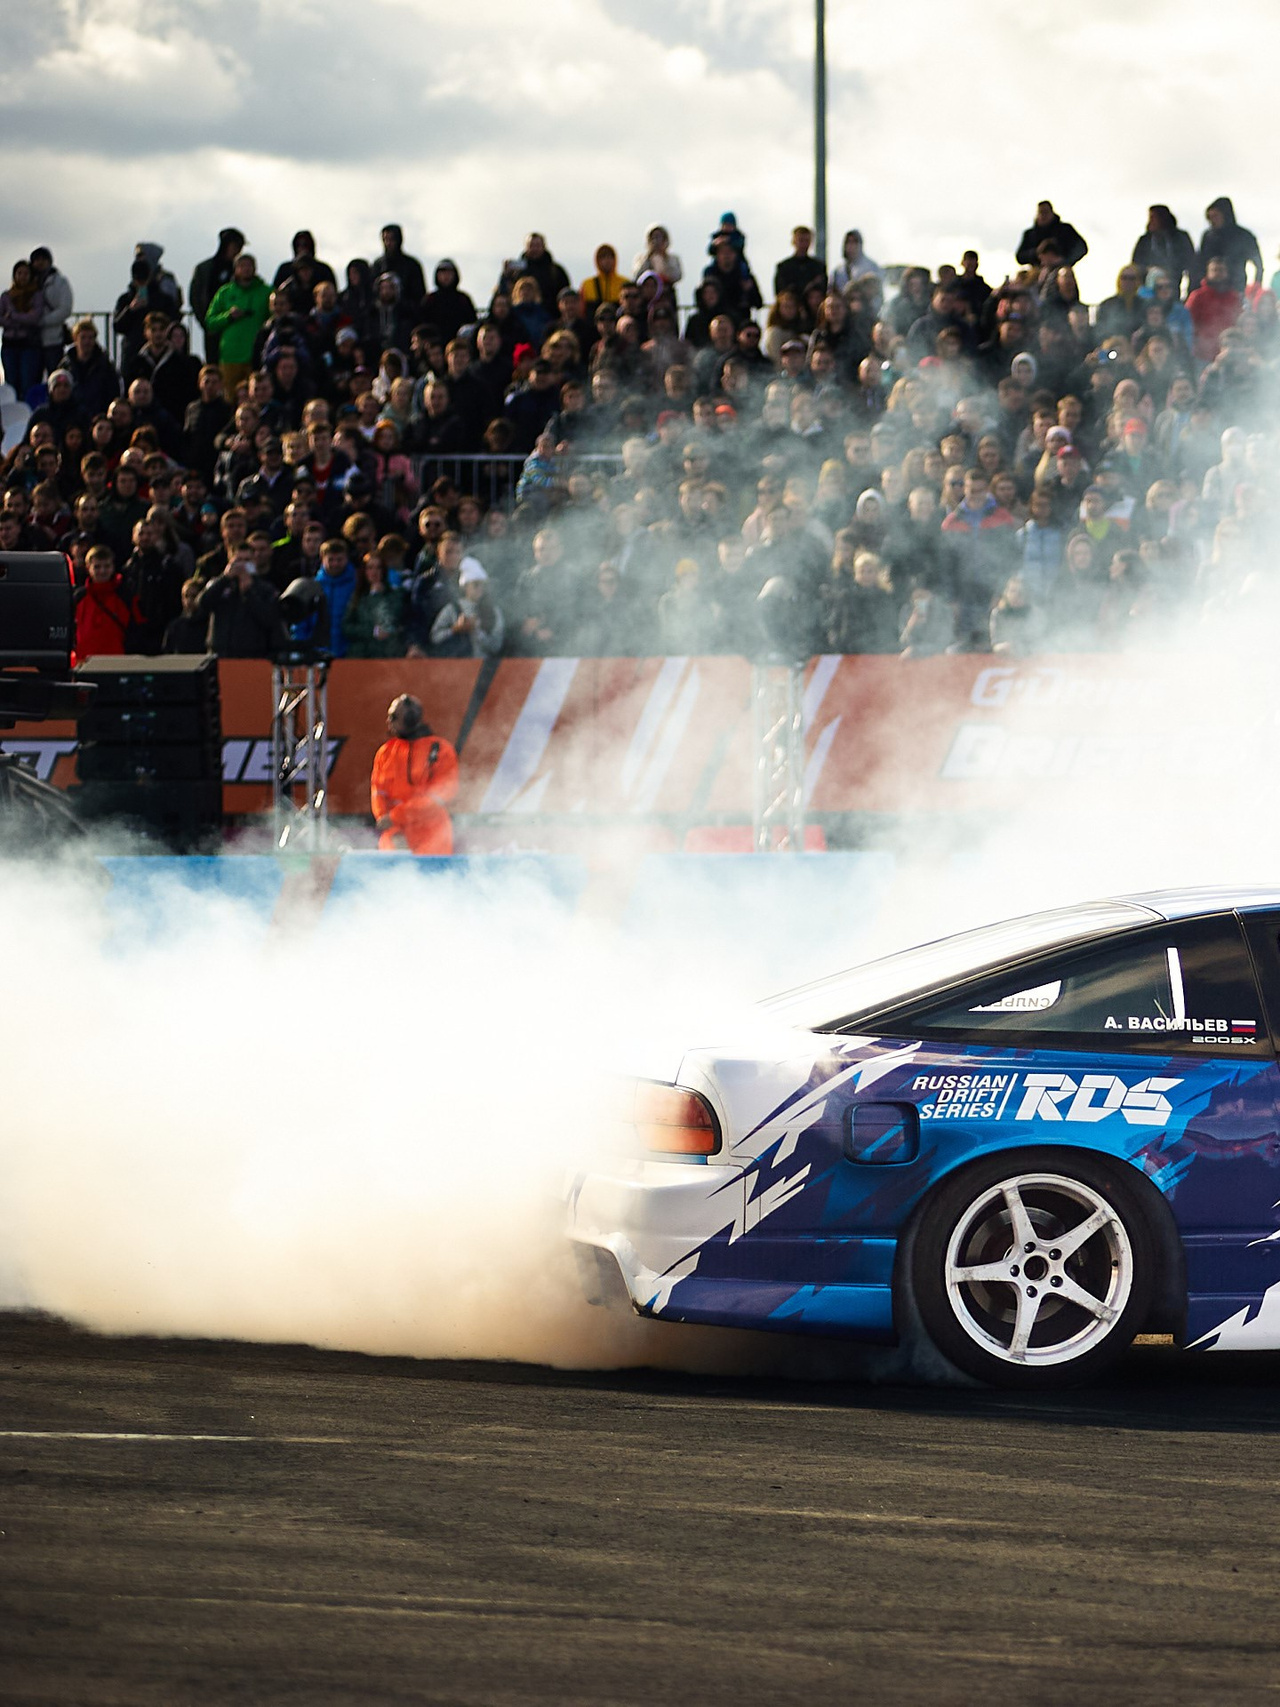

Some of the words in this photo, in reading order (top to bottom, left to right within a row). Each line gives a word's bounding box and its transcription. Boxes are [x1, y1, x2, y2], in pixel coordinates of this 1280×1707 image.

[1104, 1016, 1123, 1029] А.
[1128, 1016, 1228, 1032] ВАСИЛЬЕВ
[1192, 1035, 1257, 1045] 200SX
[912, 1075, 1008, 1091] RUSSIAN
[937, 1088, 1004, 1104] DRIFT
[1015, 1073, 1185, 1126] RDS
[919, 1102, 996, 1119] SERIES
